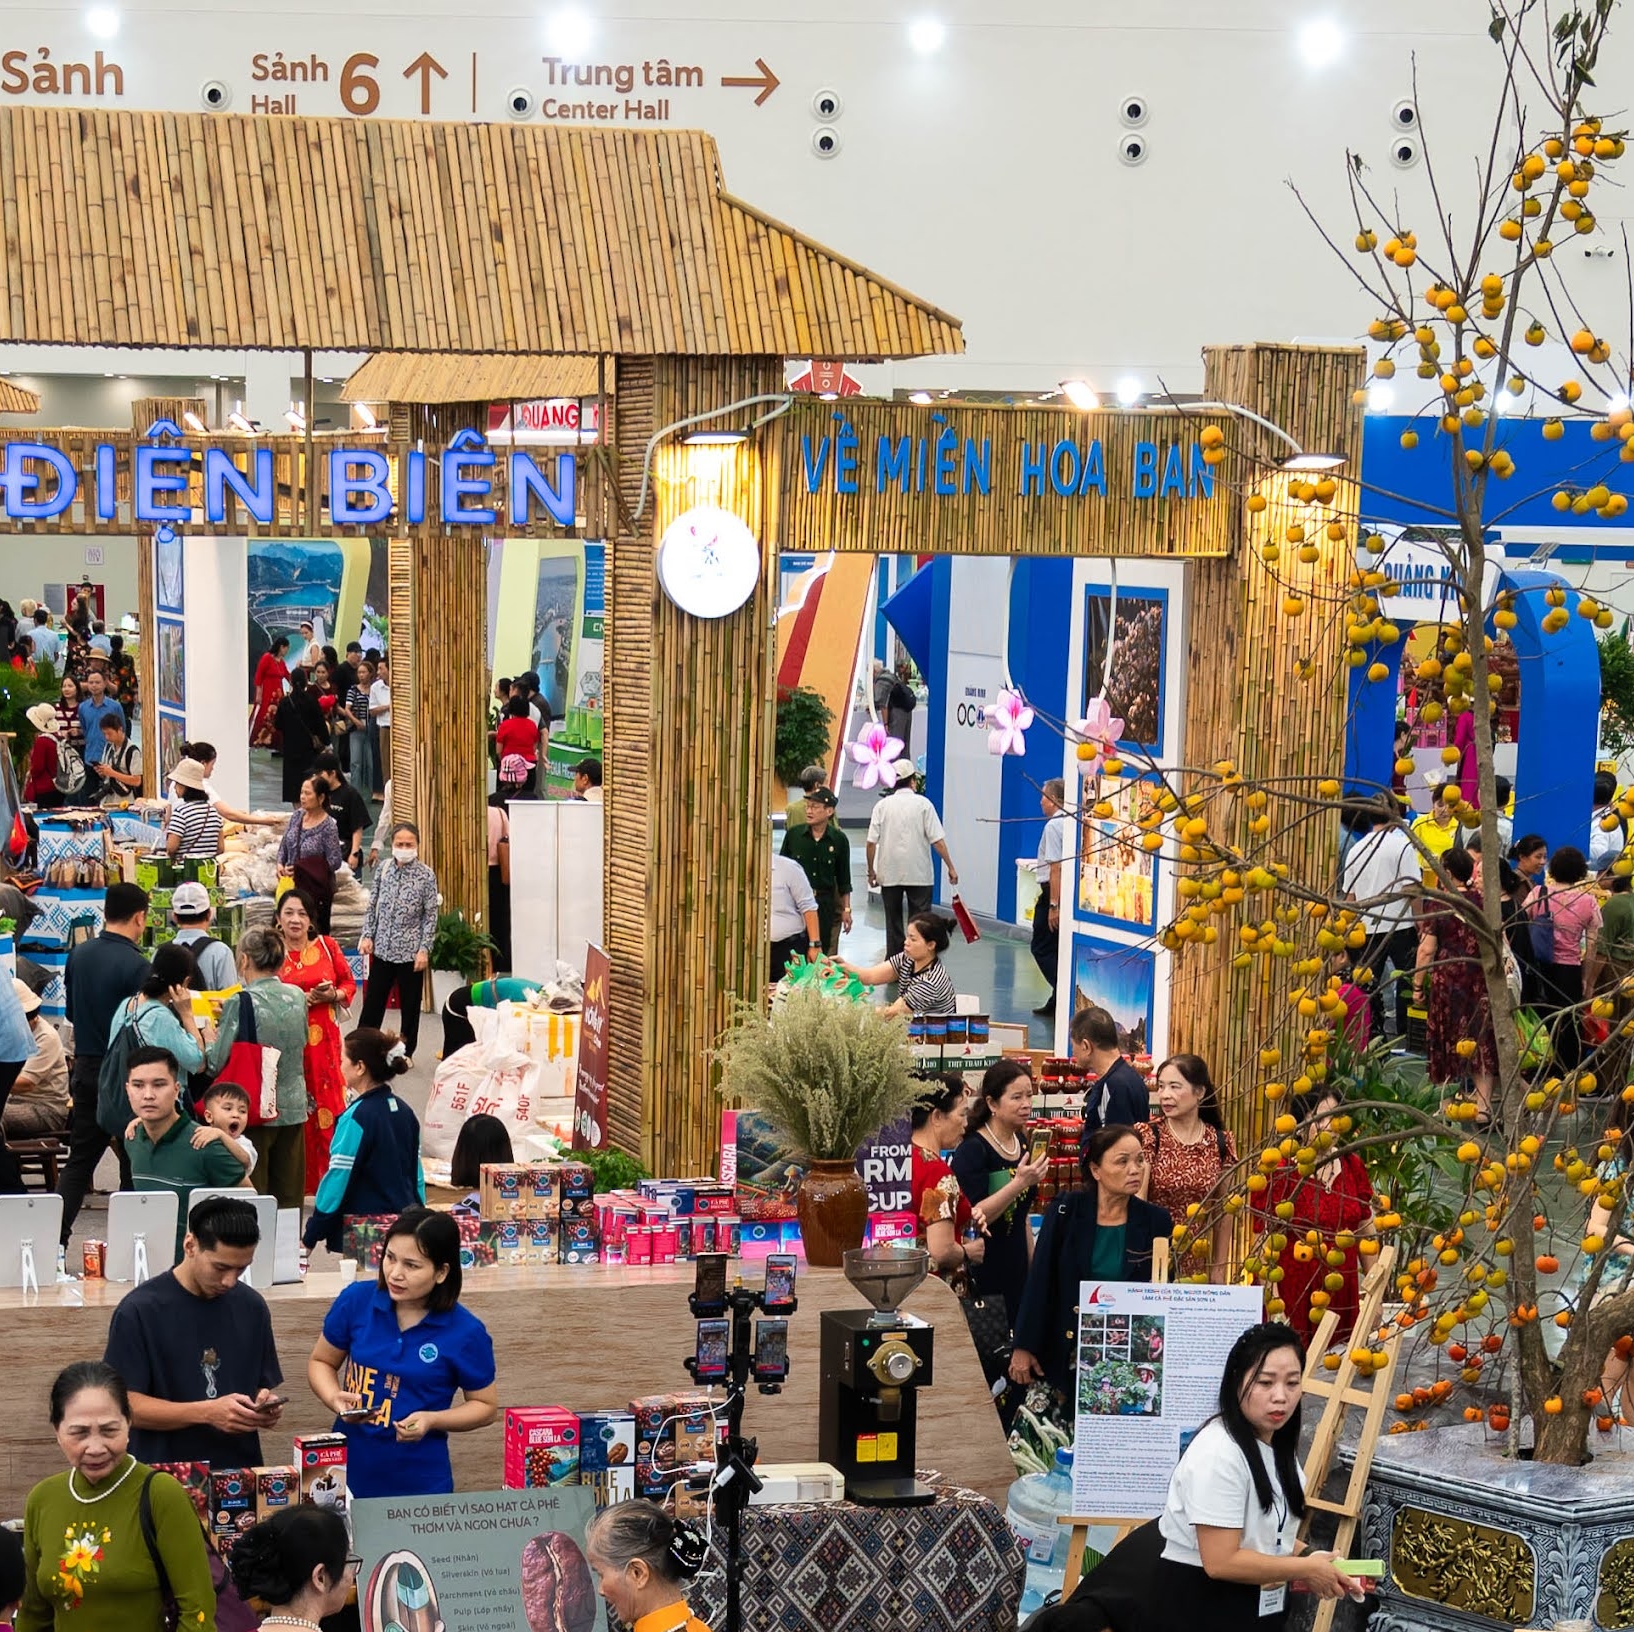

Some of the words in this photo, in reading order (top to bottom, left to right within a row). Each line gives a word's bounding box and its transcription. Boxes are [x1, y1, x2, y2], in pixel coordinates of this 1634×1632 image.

[0, 51, 124, 96] Sảnh
[251, 54, 329, 83] Sảnh
[340, 53, 380, 116] 6
[542, 57, 634, 95] Trung
[644, 57, 703, 88] tâm
[251, 94, 296, 116] Hall
[542, 98, 619, 121] Center
[625, 99, 669, 121] Hall
[802, 412, 860, 494] VỀ
[877, 414, 991, 497] MIỀN
[1022, 439, 1108, 498] HOA
[1133, 441, 1217, 499] BAN
[331, 428, 577, 526] BIÊN
[871, 1144, 912, 1157] FROM
[864, 1157, 912, 1183] RM
[868, 1191, 912, 1212] CUP
[387, 1509, 411, 1521] BẠN
[414, 1504, 429, 1518] CÓ
[432, 1502, 456, 1516] BIẾT
[458, 1502, 469, 1514] VÌ
[471, 1504, 494, 1514] SAO
[520, 1499, 534, 1511] CÀ
[537, 1496, 560, 1510] PHÊ
[411, 1520, 445, 1534] THƠM
[446, 1520, 462, 1532] VÀ
[464, 1518, 497, 1531] NGON
[500, 1517, 530, 1528] CHƯA
[439, 1590, 482, 1600] Parchment
[454, 1608, 471, 1616] Pulp
[458, 1624, 475, 1632] Skin
